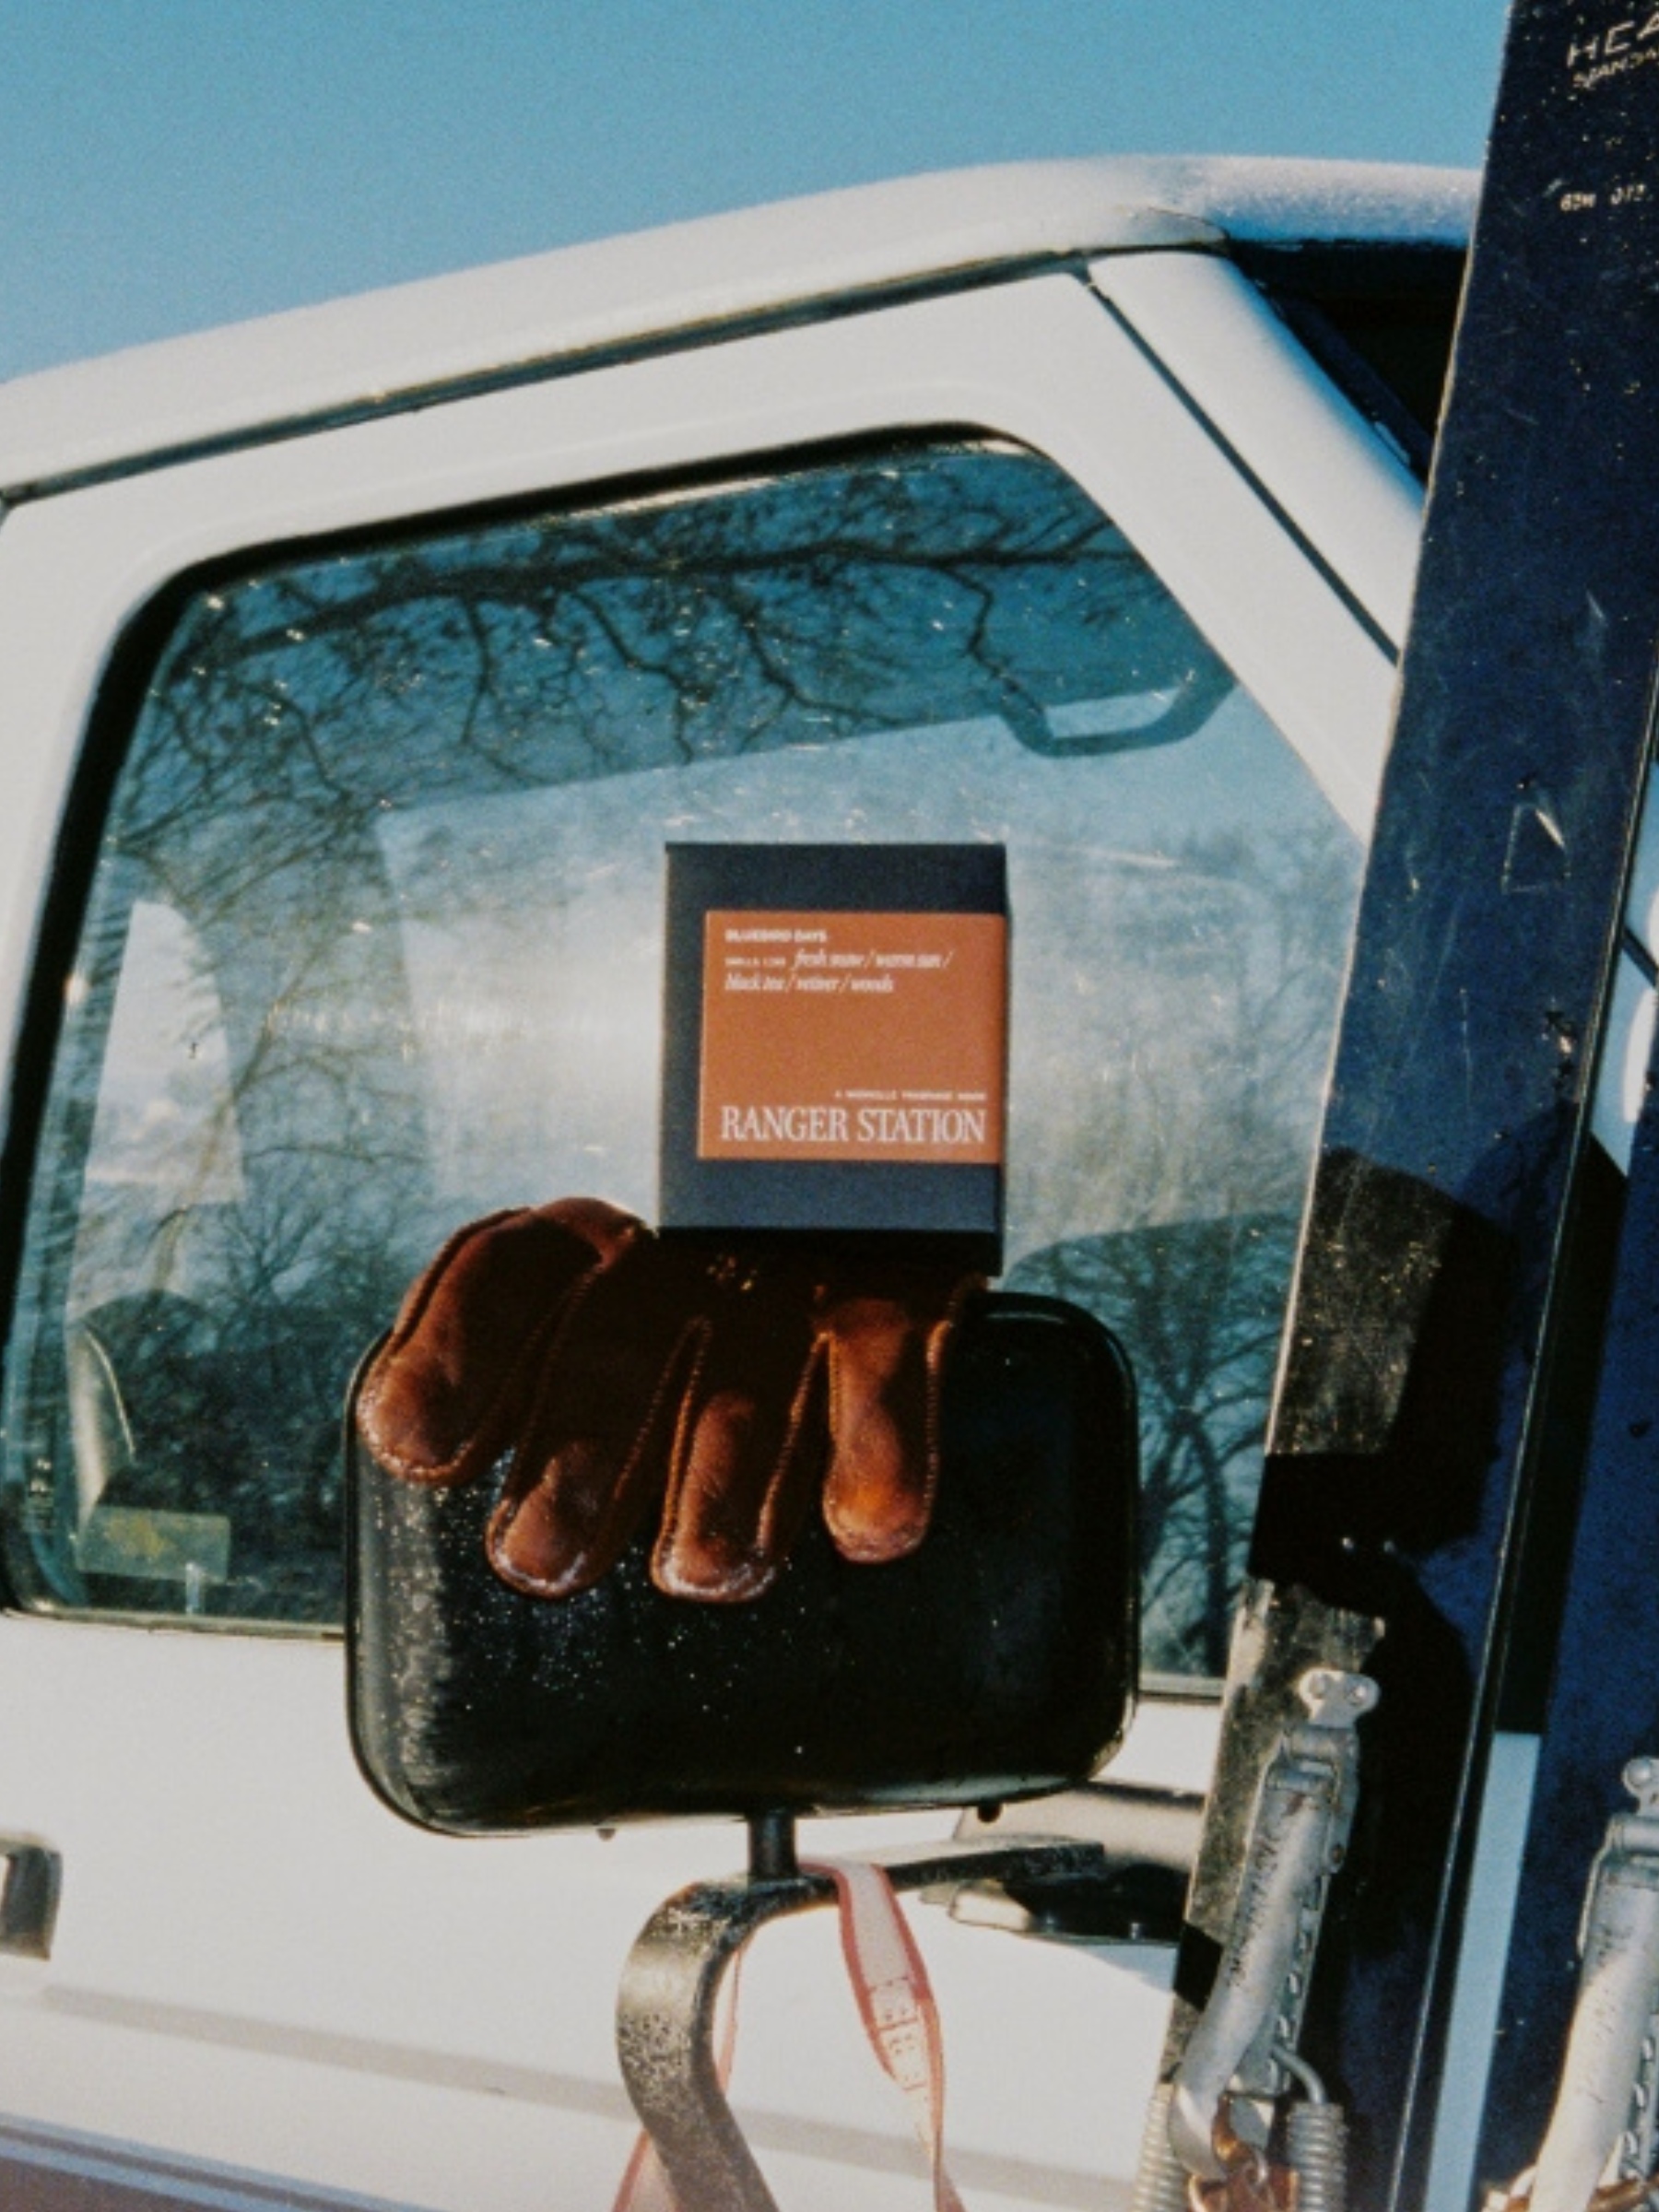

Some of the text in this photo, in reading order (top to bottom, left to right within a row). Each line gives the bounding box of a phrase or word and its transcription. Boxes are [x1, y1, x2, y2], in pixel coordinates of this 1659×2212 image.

[725, 929, 827, 942] BLUEBIRD DAYS
[791, 948, 826, 971] fresh
[830, 954, 865, 968] snow
[876, 954, 915, 969] warm
[916, 954, 942, 969] sun
[725, 973, 760, 990] black
[761, 975, 783, 991] tea
[796, 977, 840, 992] vetiver
[720, 1105, 987, 1143] RANGER STATION
